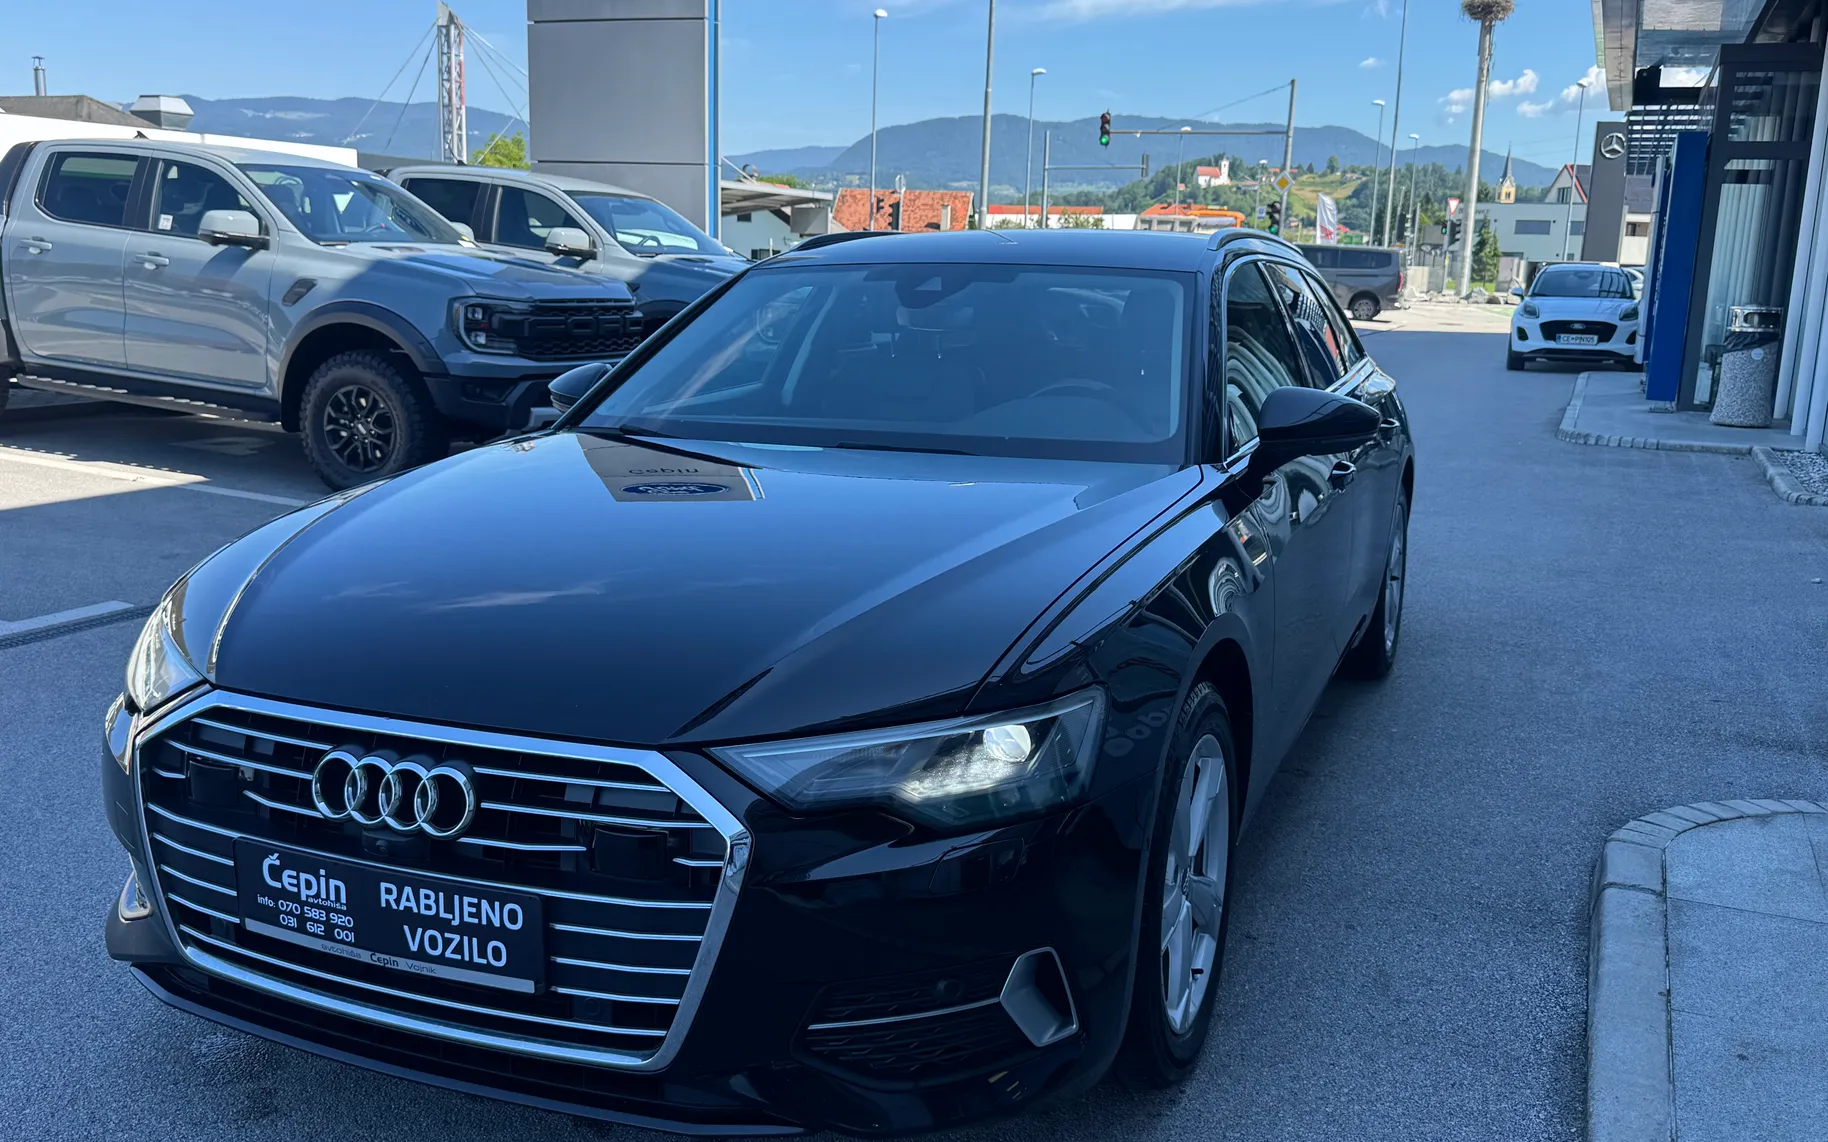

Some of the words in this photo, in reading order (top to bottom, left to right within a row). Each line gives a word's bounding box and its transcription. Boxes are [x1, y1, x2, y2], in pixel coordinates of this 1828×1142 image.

[262, 852, 347, 904] Čepin
[257, 894, 276, 908] info:
[278, 899, 301, 914] 070
[304, 906, 326, 921] 583
[329, 912, 354, 928] 920
[379, 881, 524, 931] RABLJENO
[279, 914, 297, 928] 031
[306, 922, 325, 936] 612
[334, 928, 355, 943] 001
[403, 924, 508, 968] VOZILO
[405, 961, 437, 974] Vojnik
